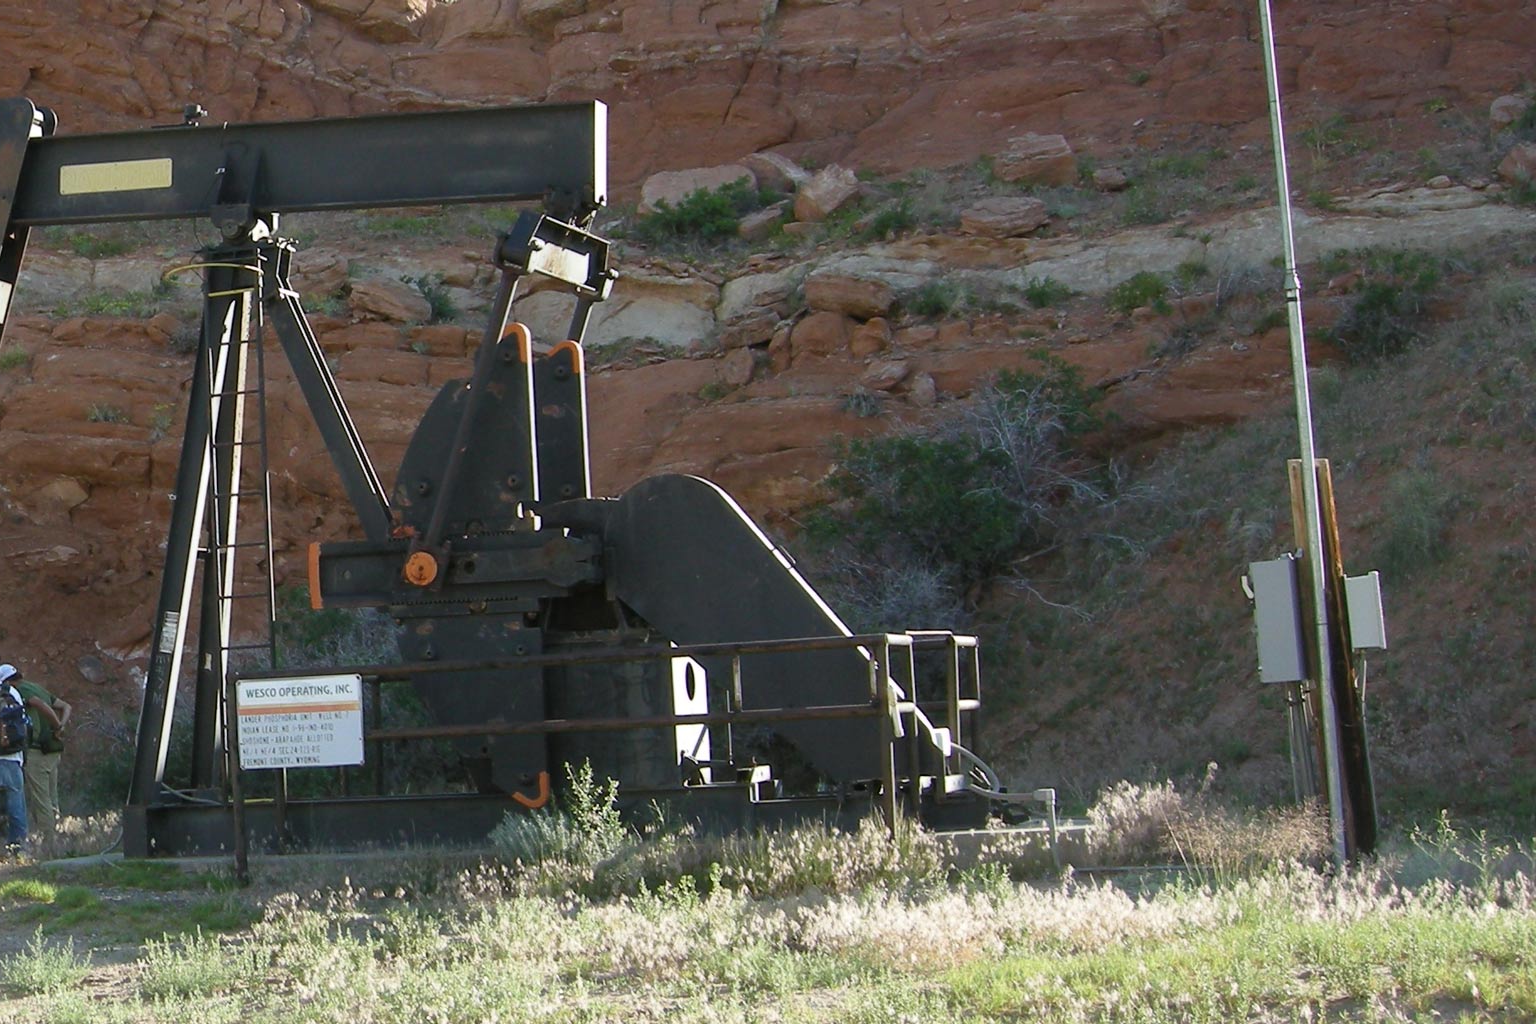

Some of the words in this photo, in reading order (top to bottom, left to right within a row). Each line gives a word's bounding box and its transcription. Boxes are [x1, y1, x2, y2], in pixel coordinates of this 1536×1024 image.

[246, 688, 276, 698] WESCO
[278, 686, 333, 697] OPERATING,
[335, 684, 352, 694] INC.
[241, 715, 261, 724] LANDER
[264, 714, 297, 723] PHOSPHORIA
[300, 712, 312, 721] UNIT
[318, 712, 332, 720] WELL
[261, 725, 279, 733] LEASE
[243, 758, 267, 767] FREMONT
[296, 756, 321, 765] WYOMING
